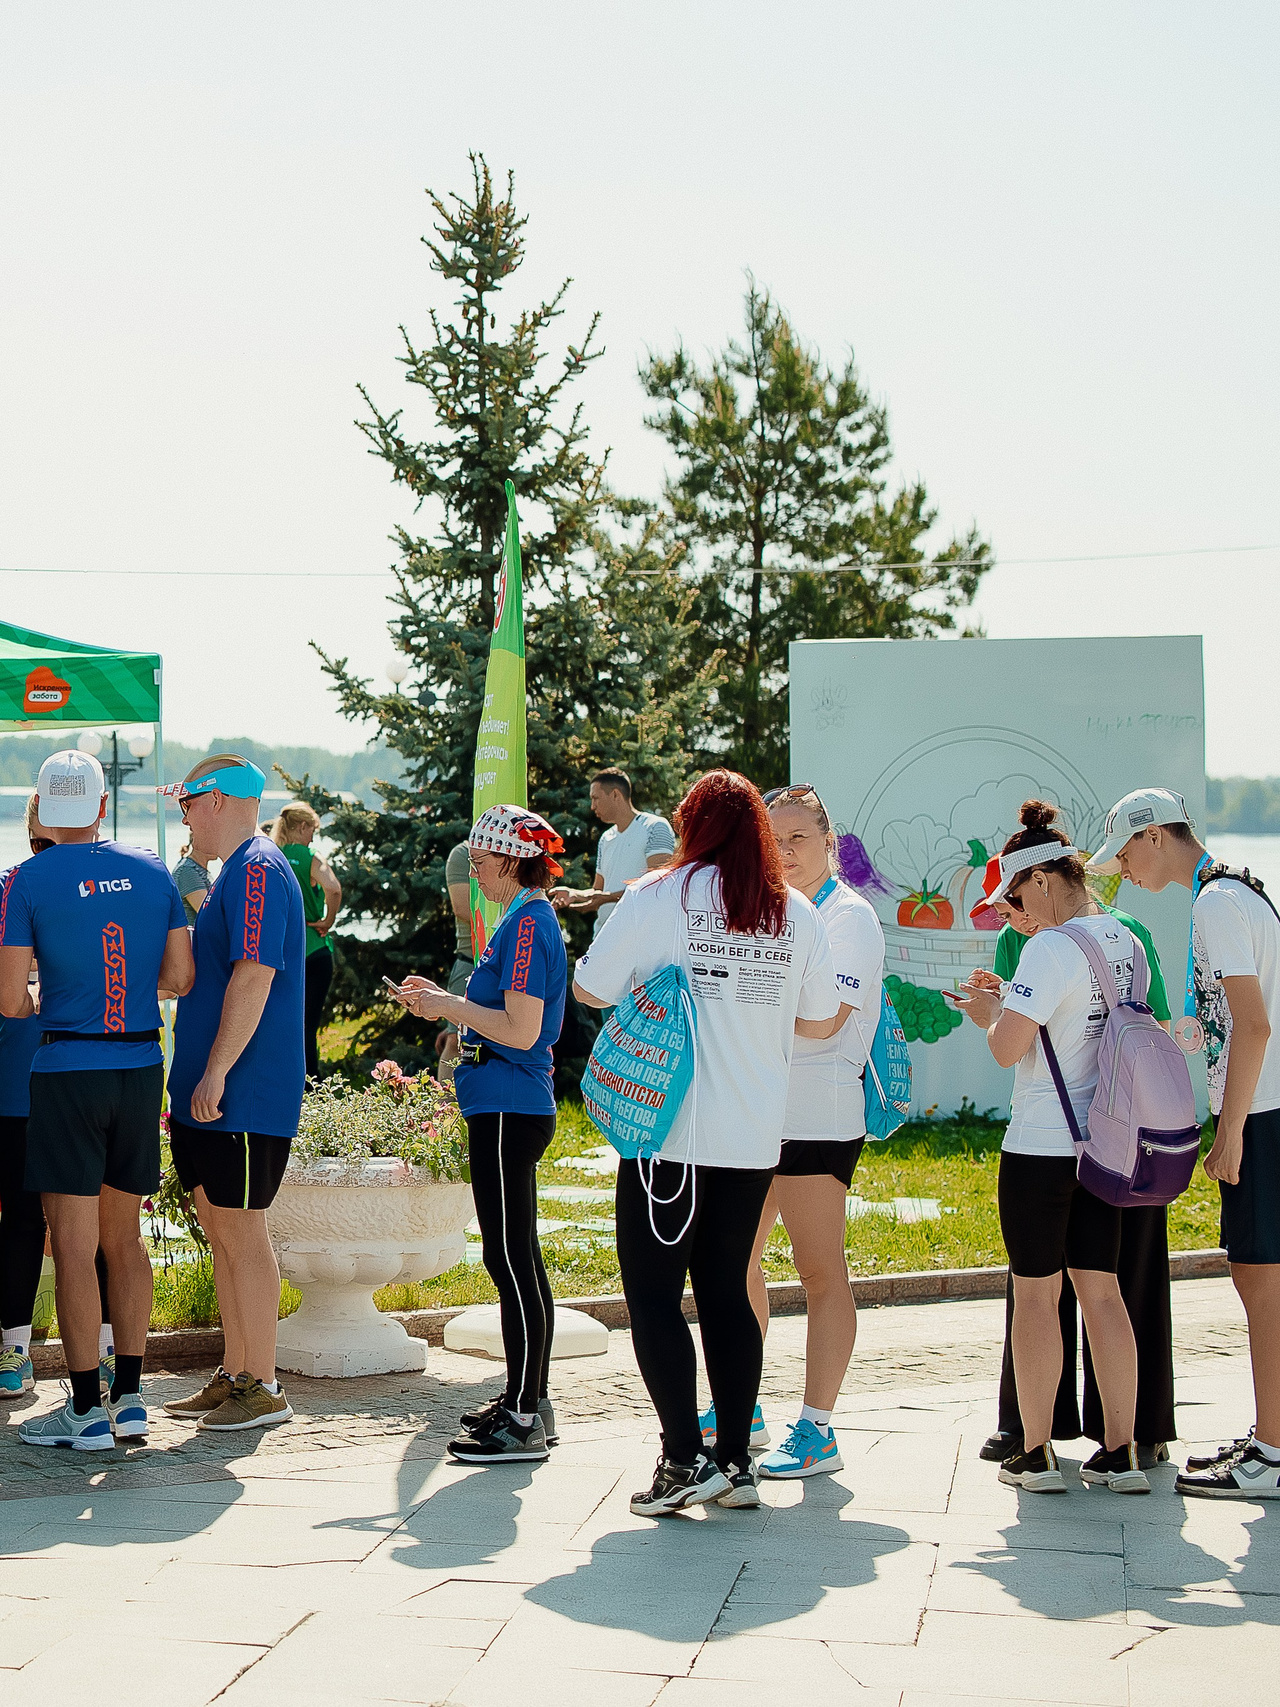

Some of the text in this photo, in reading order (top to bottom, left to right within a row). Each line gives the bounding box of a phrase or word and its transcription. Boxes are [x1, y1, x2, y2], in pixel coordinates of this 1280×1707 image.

[99, 878, 132, 893] ПСБ
[688, 942, 793, 963] ЛЮБИ БЕГ В СЕБЕ
[836, 974, 860, 989] ПСБ
[597, 1066, 624, 1093] ДАВНО
[624, 1081, 666, 1109] ОТСТАЛ
[642, 1066, 673, 1090] ПЕРЕ
[613, 1097, 657, 1128] #БЕГОВА
